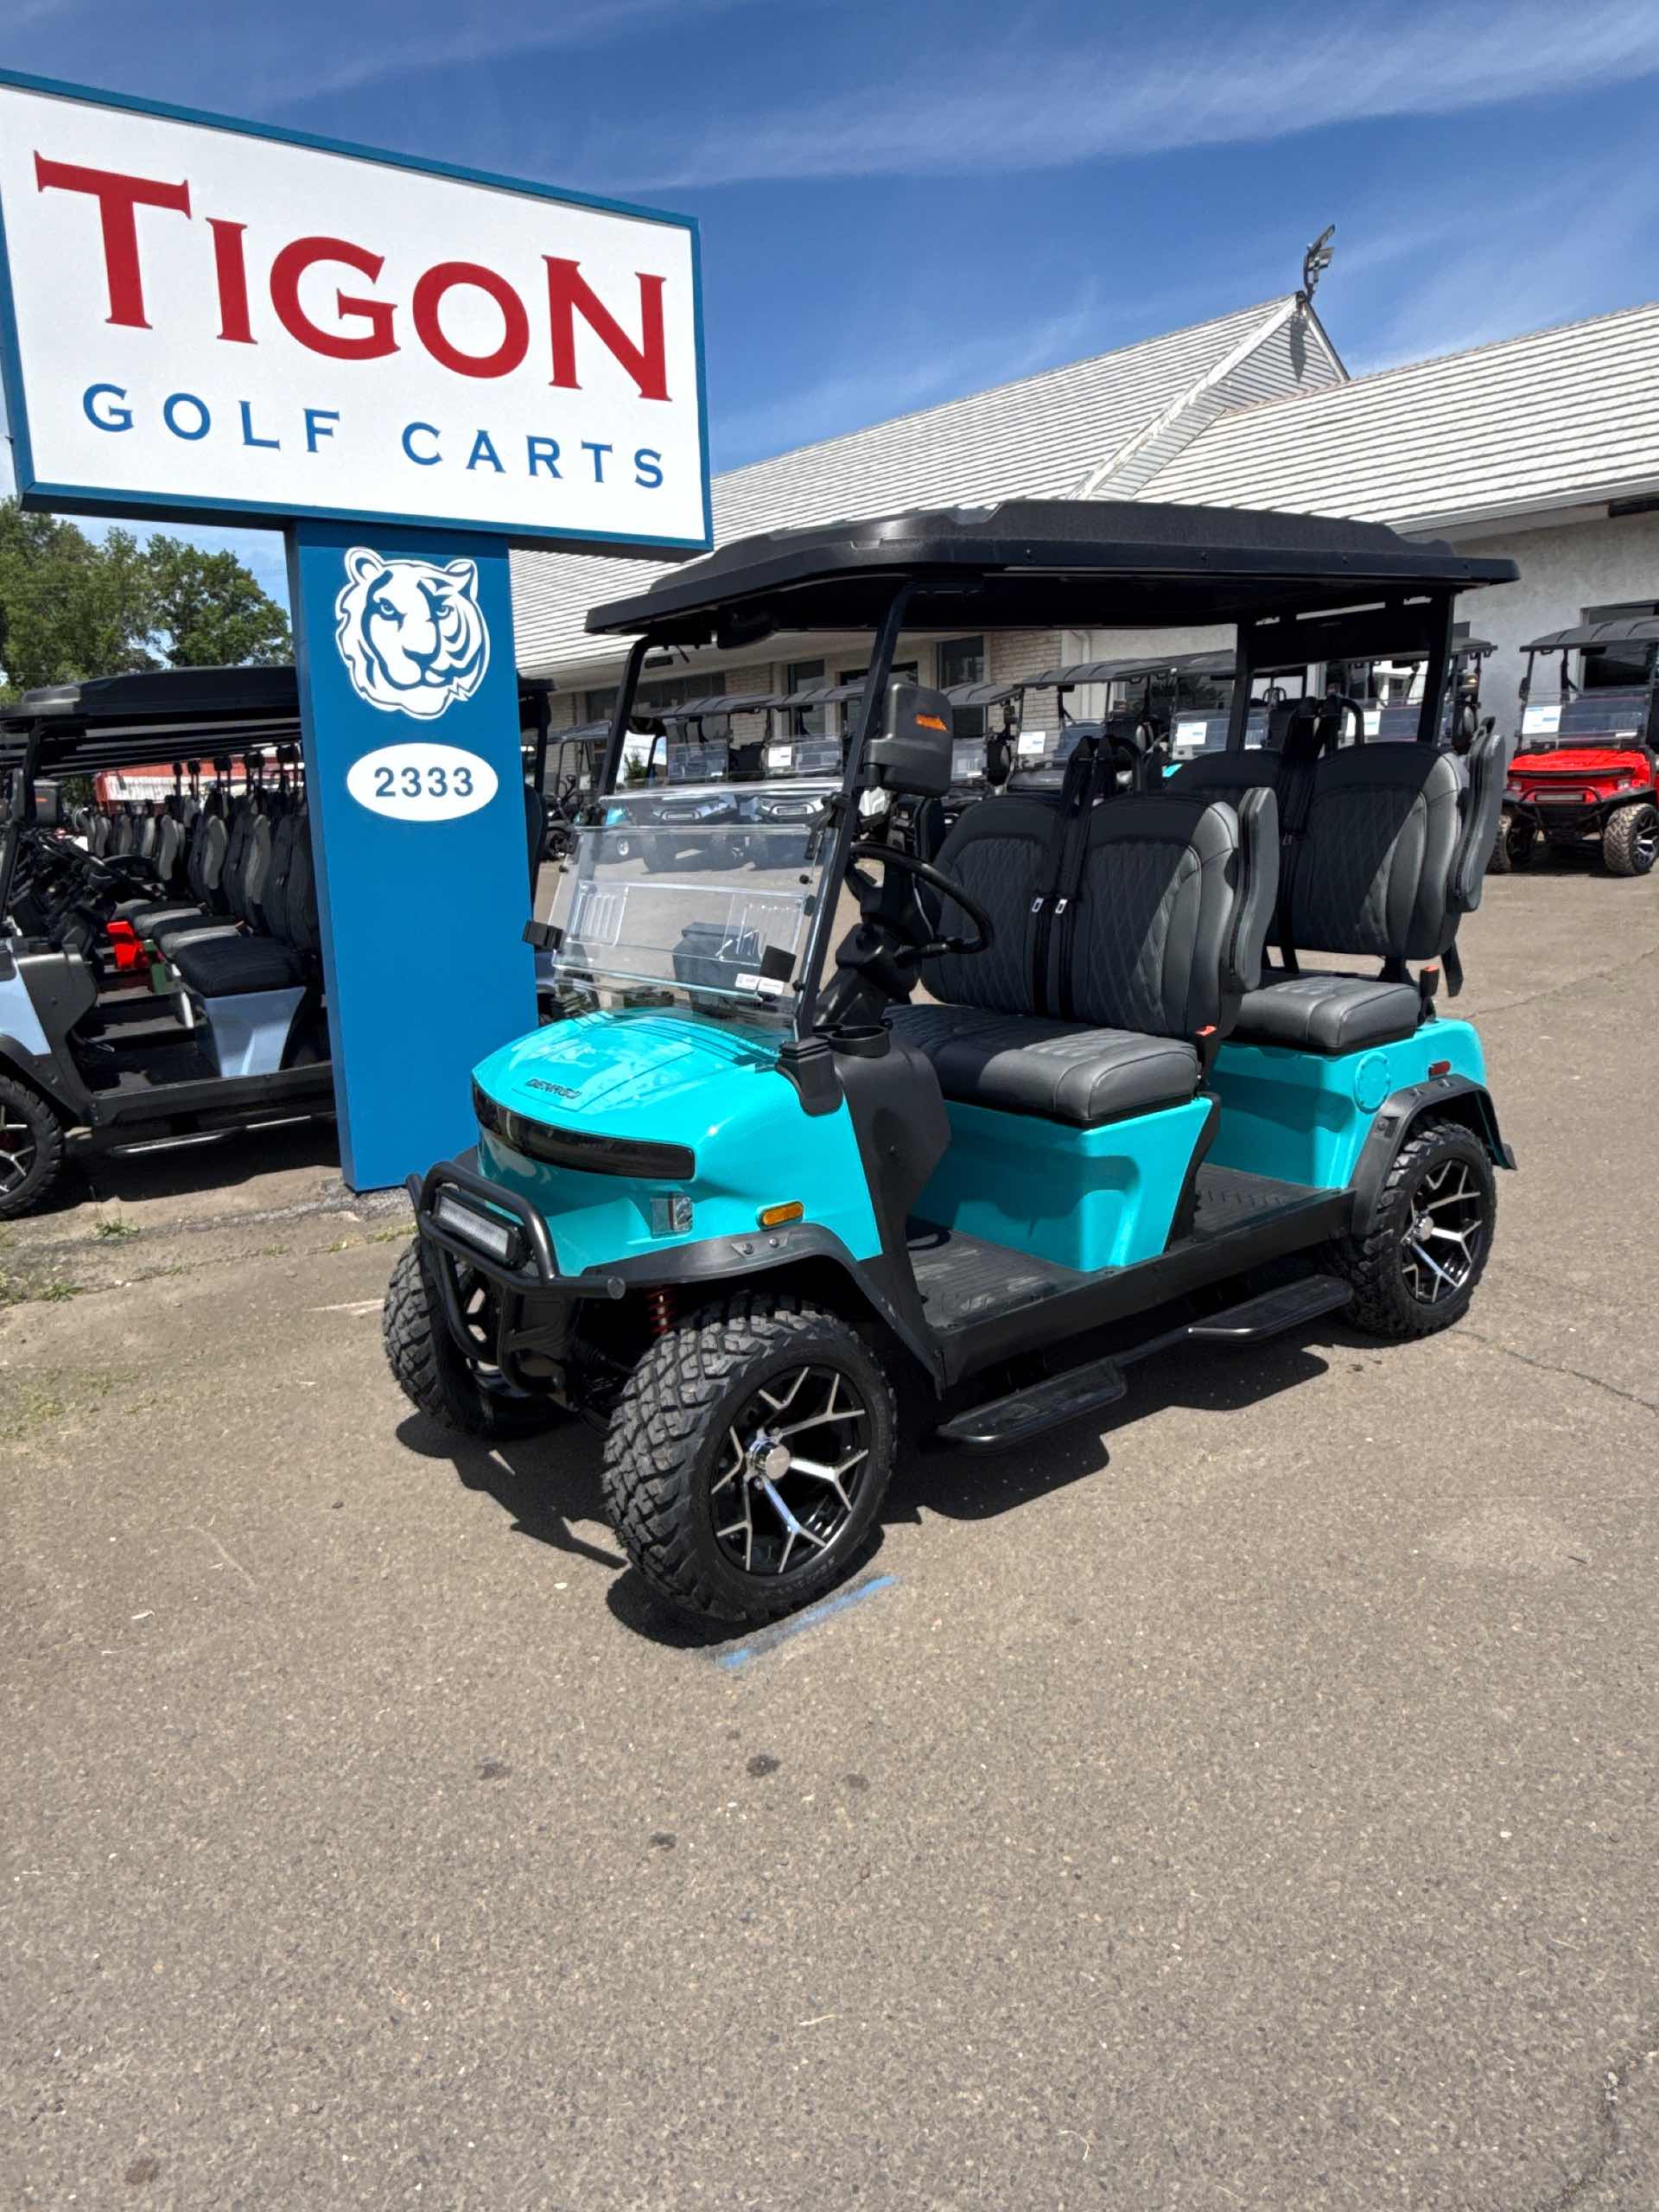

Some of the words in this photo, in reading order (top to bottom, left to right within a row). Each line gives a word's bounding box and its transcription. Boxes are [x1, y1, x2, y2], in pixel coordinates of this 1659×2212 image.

[34, 150, 672, 402] TIGON
[83, 383, 340, 454] GOLF
[401, 422, 664, 489] CARTS
[374, 766, 474, 798] 2333
